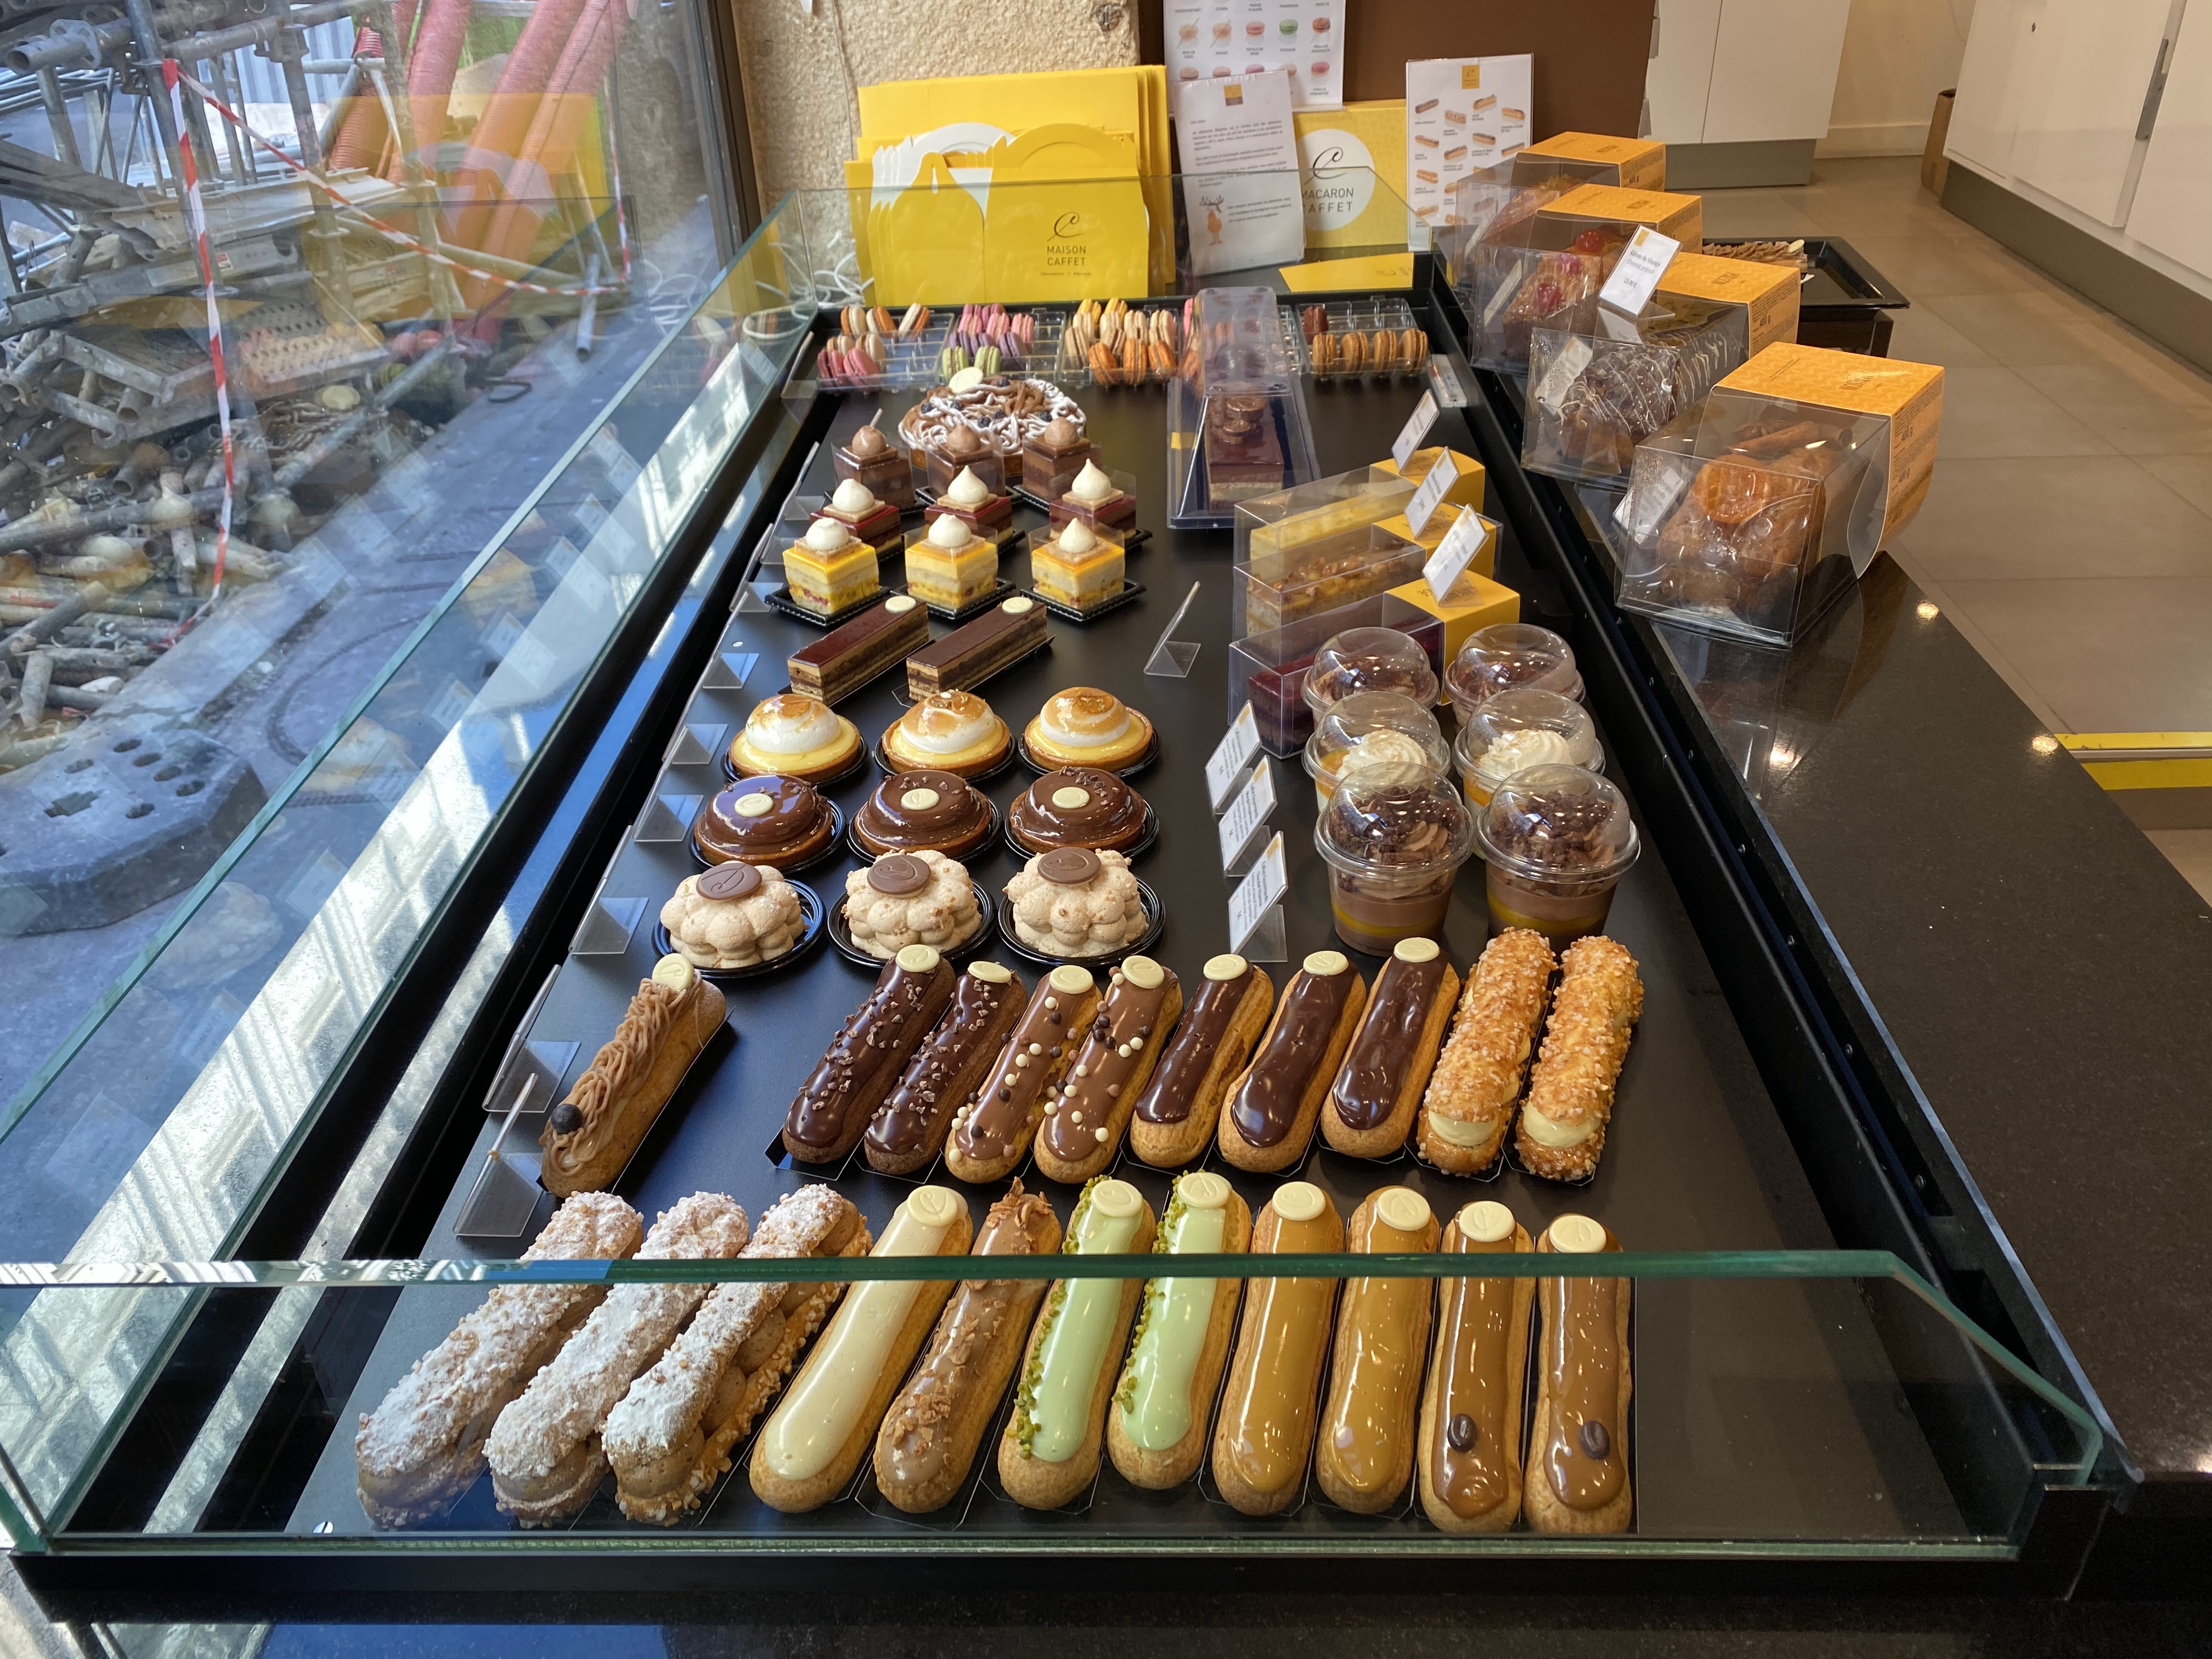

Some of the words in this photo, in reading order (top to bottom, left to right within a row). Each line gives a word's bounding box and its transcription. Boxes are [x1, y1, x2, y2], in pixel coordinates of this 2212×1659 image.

[1302, 188, 1353, 198] MACARON
[1047, 245, 1086, 254] MAISON
[1047, 257, 1086, 266] CAFFET
[1647, 257, 1661, 268] Voyage
